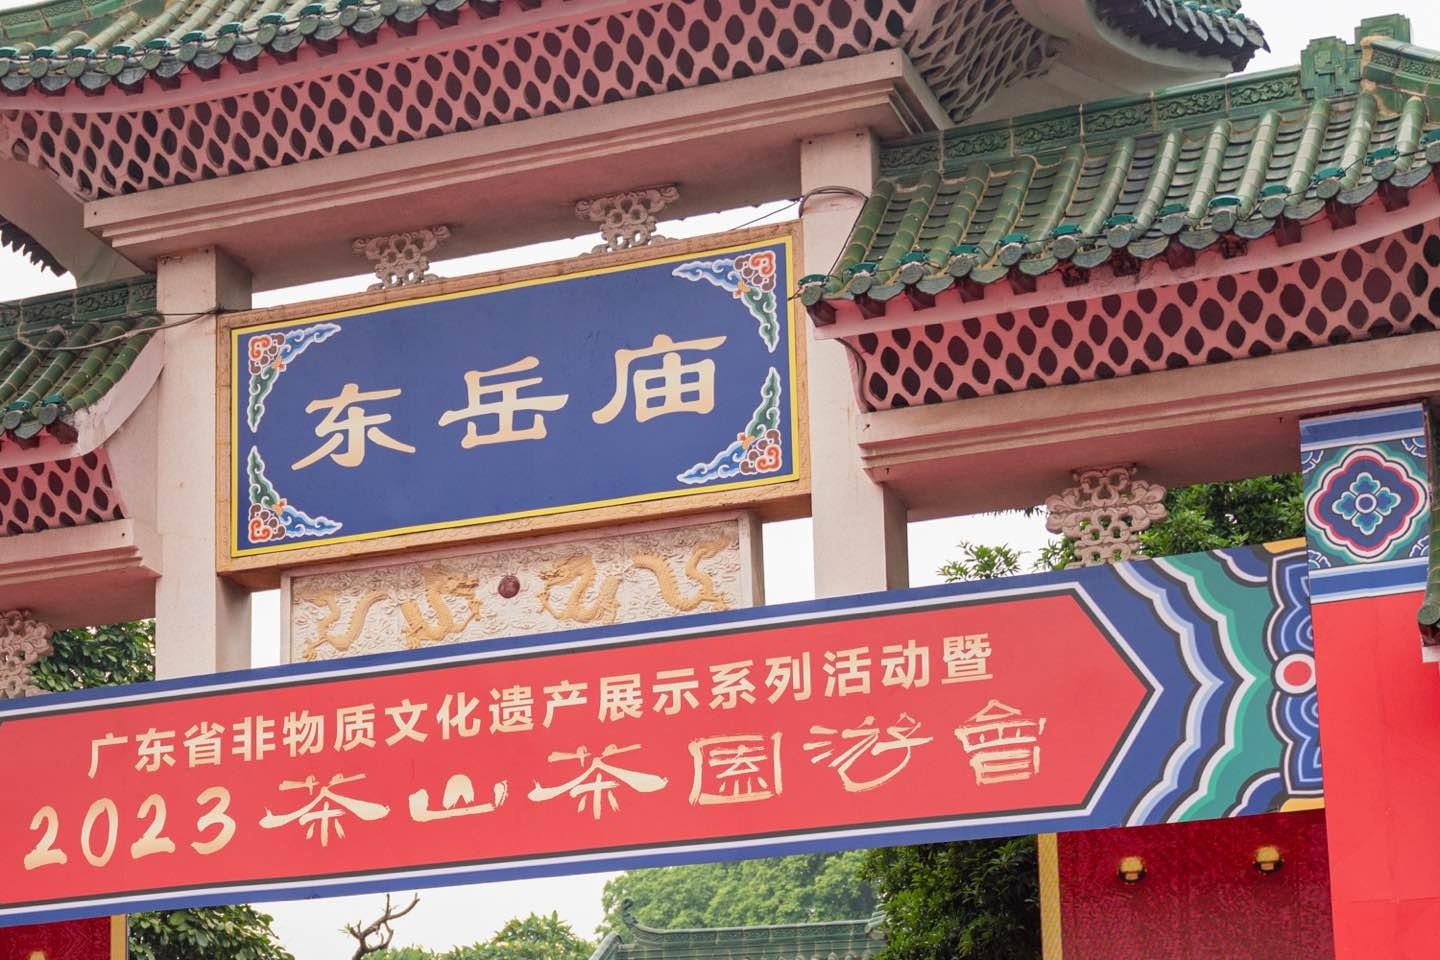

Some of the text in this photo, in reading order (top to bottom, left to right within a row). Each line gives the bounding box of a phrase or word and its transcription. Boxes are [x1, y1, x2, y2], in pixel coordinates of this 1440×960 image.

[291, 334, 728, 471] 东岳庙
[87, 633, 994, 780] 广东省非物质文化遗产展示系列活动暨
